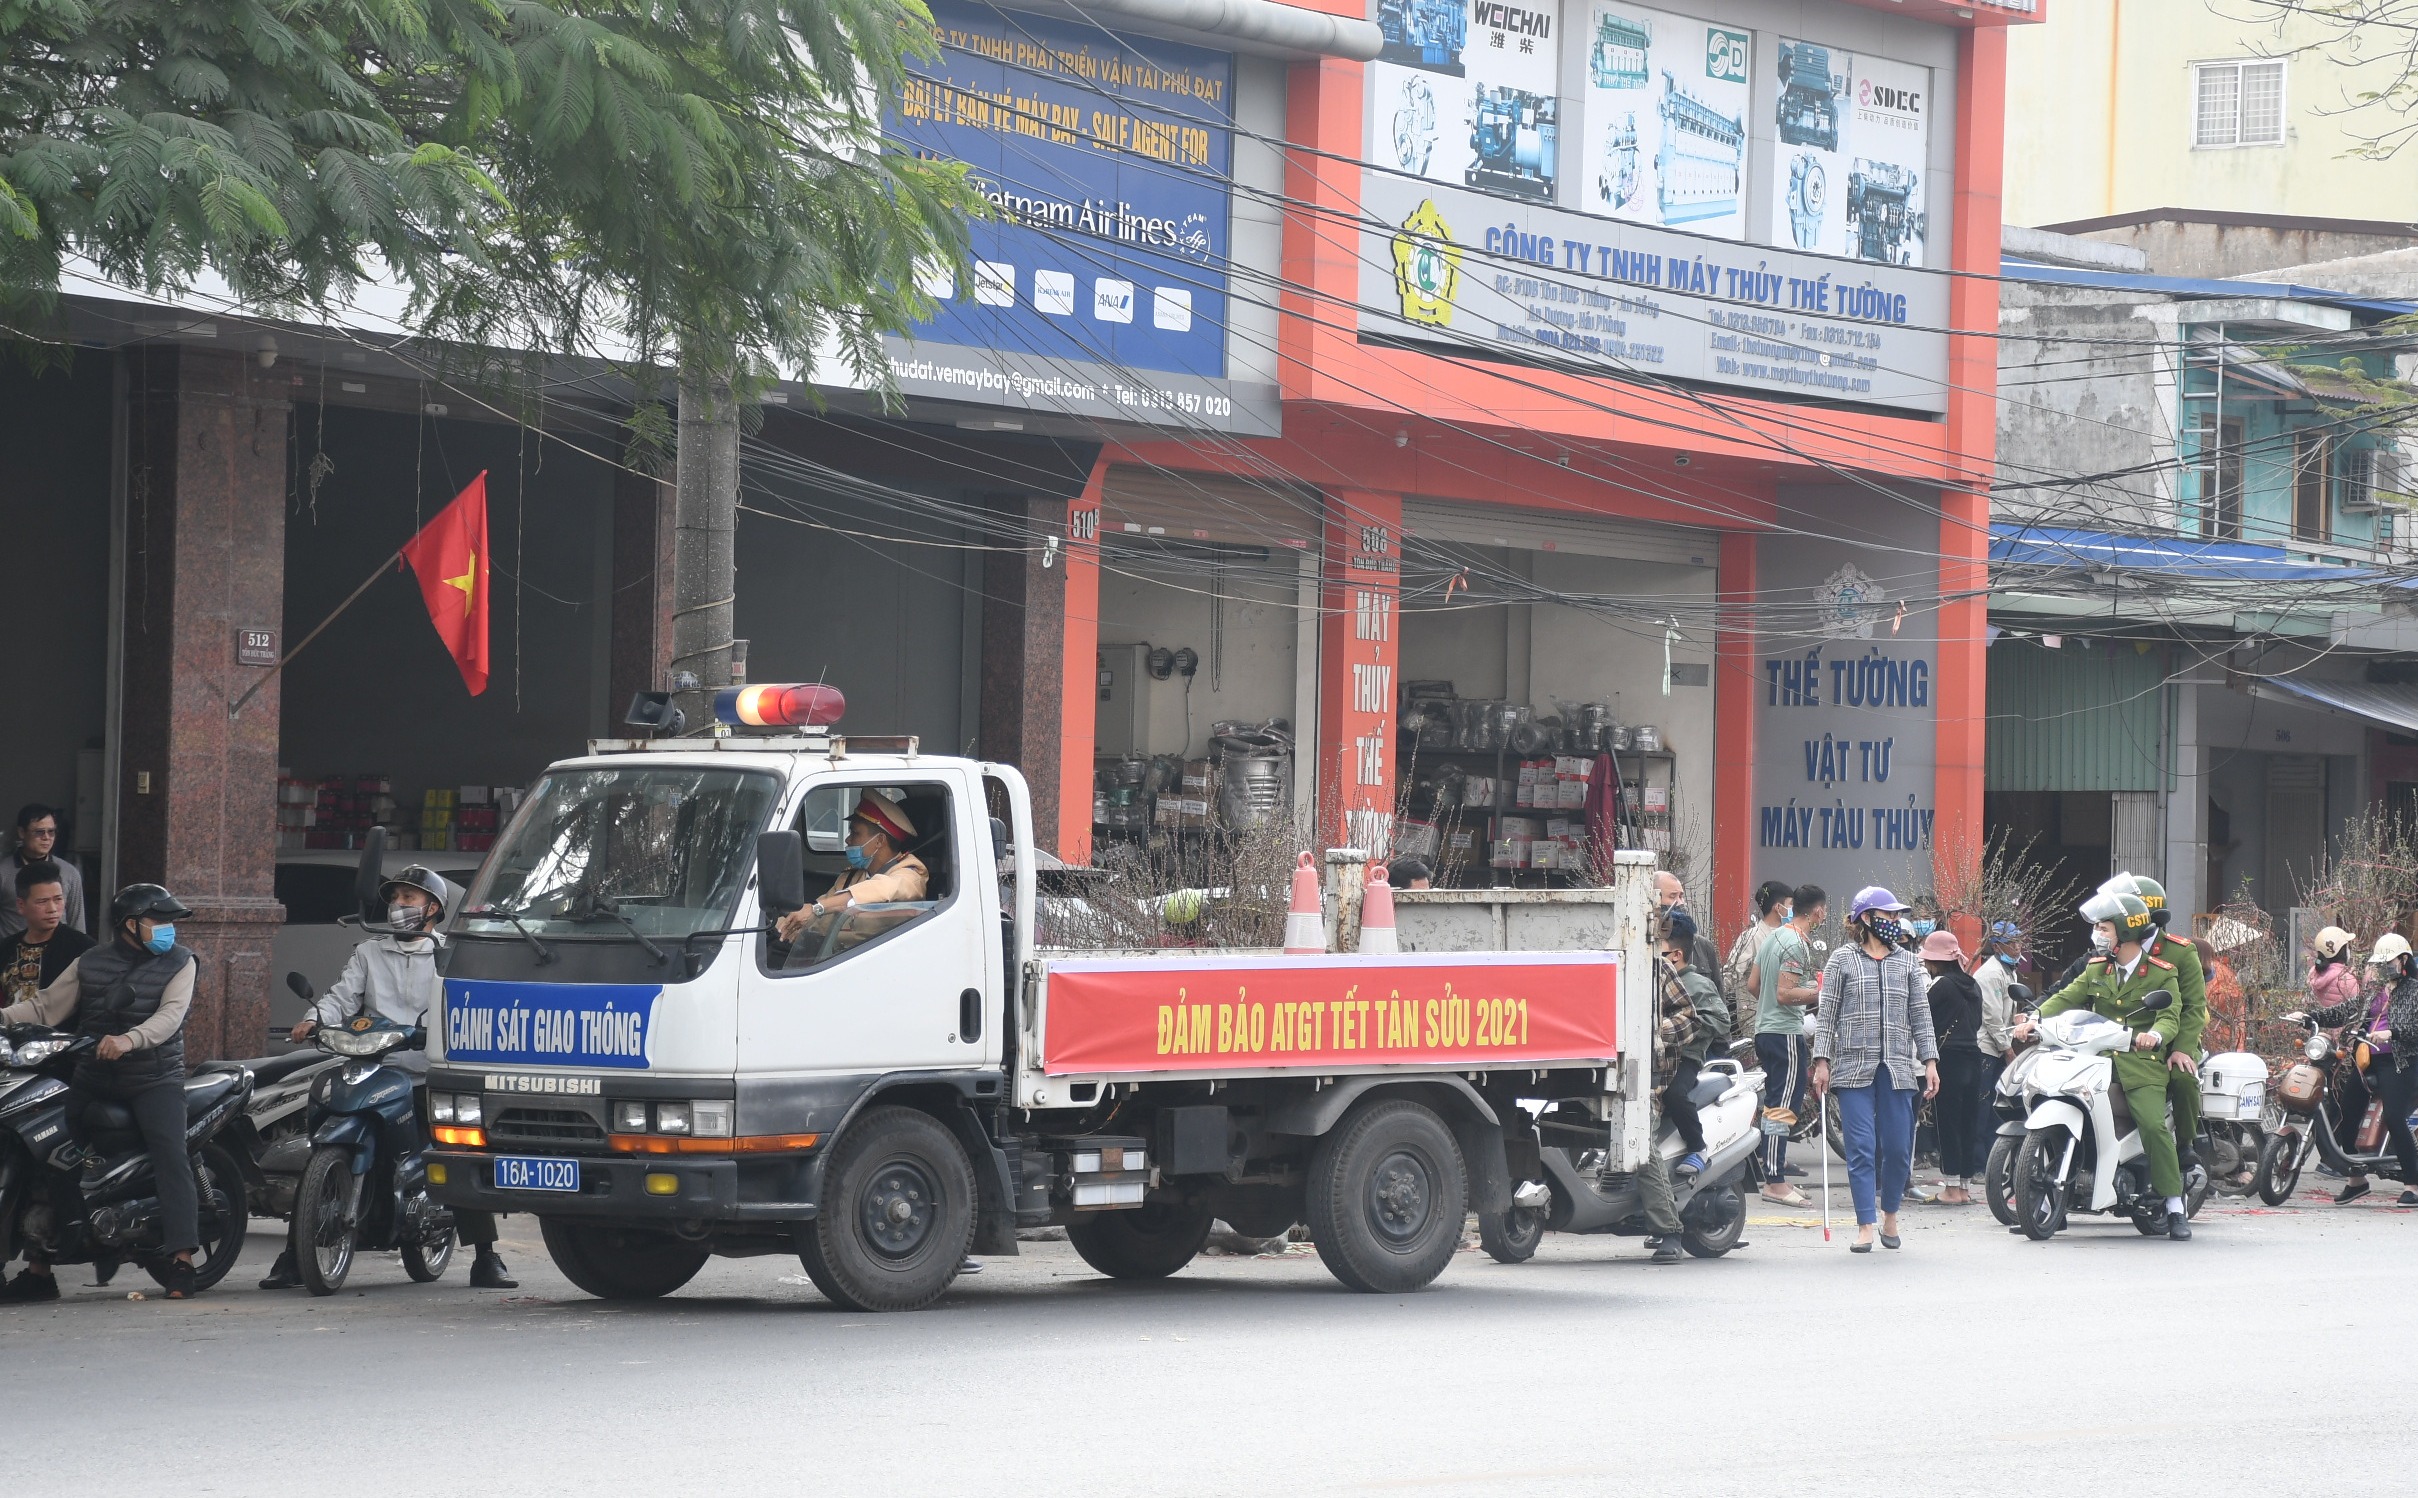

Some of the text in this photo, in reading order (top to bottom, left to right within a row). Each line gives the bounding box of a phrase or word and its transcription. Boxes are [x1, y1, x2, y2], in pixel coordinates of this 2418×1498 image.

[1475, 0, 1551, 38] WEICHAI
[972, 34, 1013, 62] TNHH
[1100, 57, 1132, 86] VẬN
[1194, 78, 1223, 103] ĐẠT
[934, 77, 953, 122] LÝ
[956, 81, 989, 129] BÁN
[1052, 104, 1080, 145] BAY
[1131, 120, 1179, 163] AGENT
[1181, 128, 1209, 166] FOR
[1874, 85, 1920, 113] SDEC
[1079, 198, 1177, 248] Airlines
[1098, 293, 1119, 308] ANA
[1485, 223, 1907, 324] CÔNG TY TNHH MÁY THỦY THẾ TƯỜNG
[887, 356, 1095, 400] hudat.vemaybay@gmail.com
[1114, 384, 1138, 406] Tel:
[1205, 395, 1231, 417] 020
[247, 633, 269, 647] 512
[1356, 582, 1391, 642] MÁY
[1353, 645, 1391, 713] THỦY
[1766, 646, 1930, 708] THẾ TƯỜNG
[1804, 732, 1895, 789] VẬT TƯ
[1760, 793, 1935, 851] MÁY TÀU THỦY
[2126, 912, 2150, 928] CSTT
[449, 991, 641, 1057] CẢNH SÁT GIAO THÔNG
[1157, 981, 1529, 1055] ĐẢM BẢO ATGT TẾT TÂN SỬU 2021
[484, 1074, 601, 1095] MITSUBISHI
[33, 1125, 59, 1143] YAMAHA
[500, 1159, 575, 1189] 16A-1020
